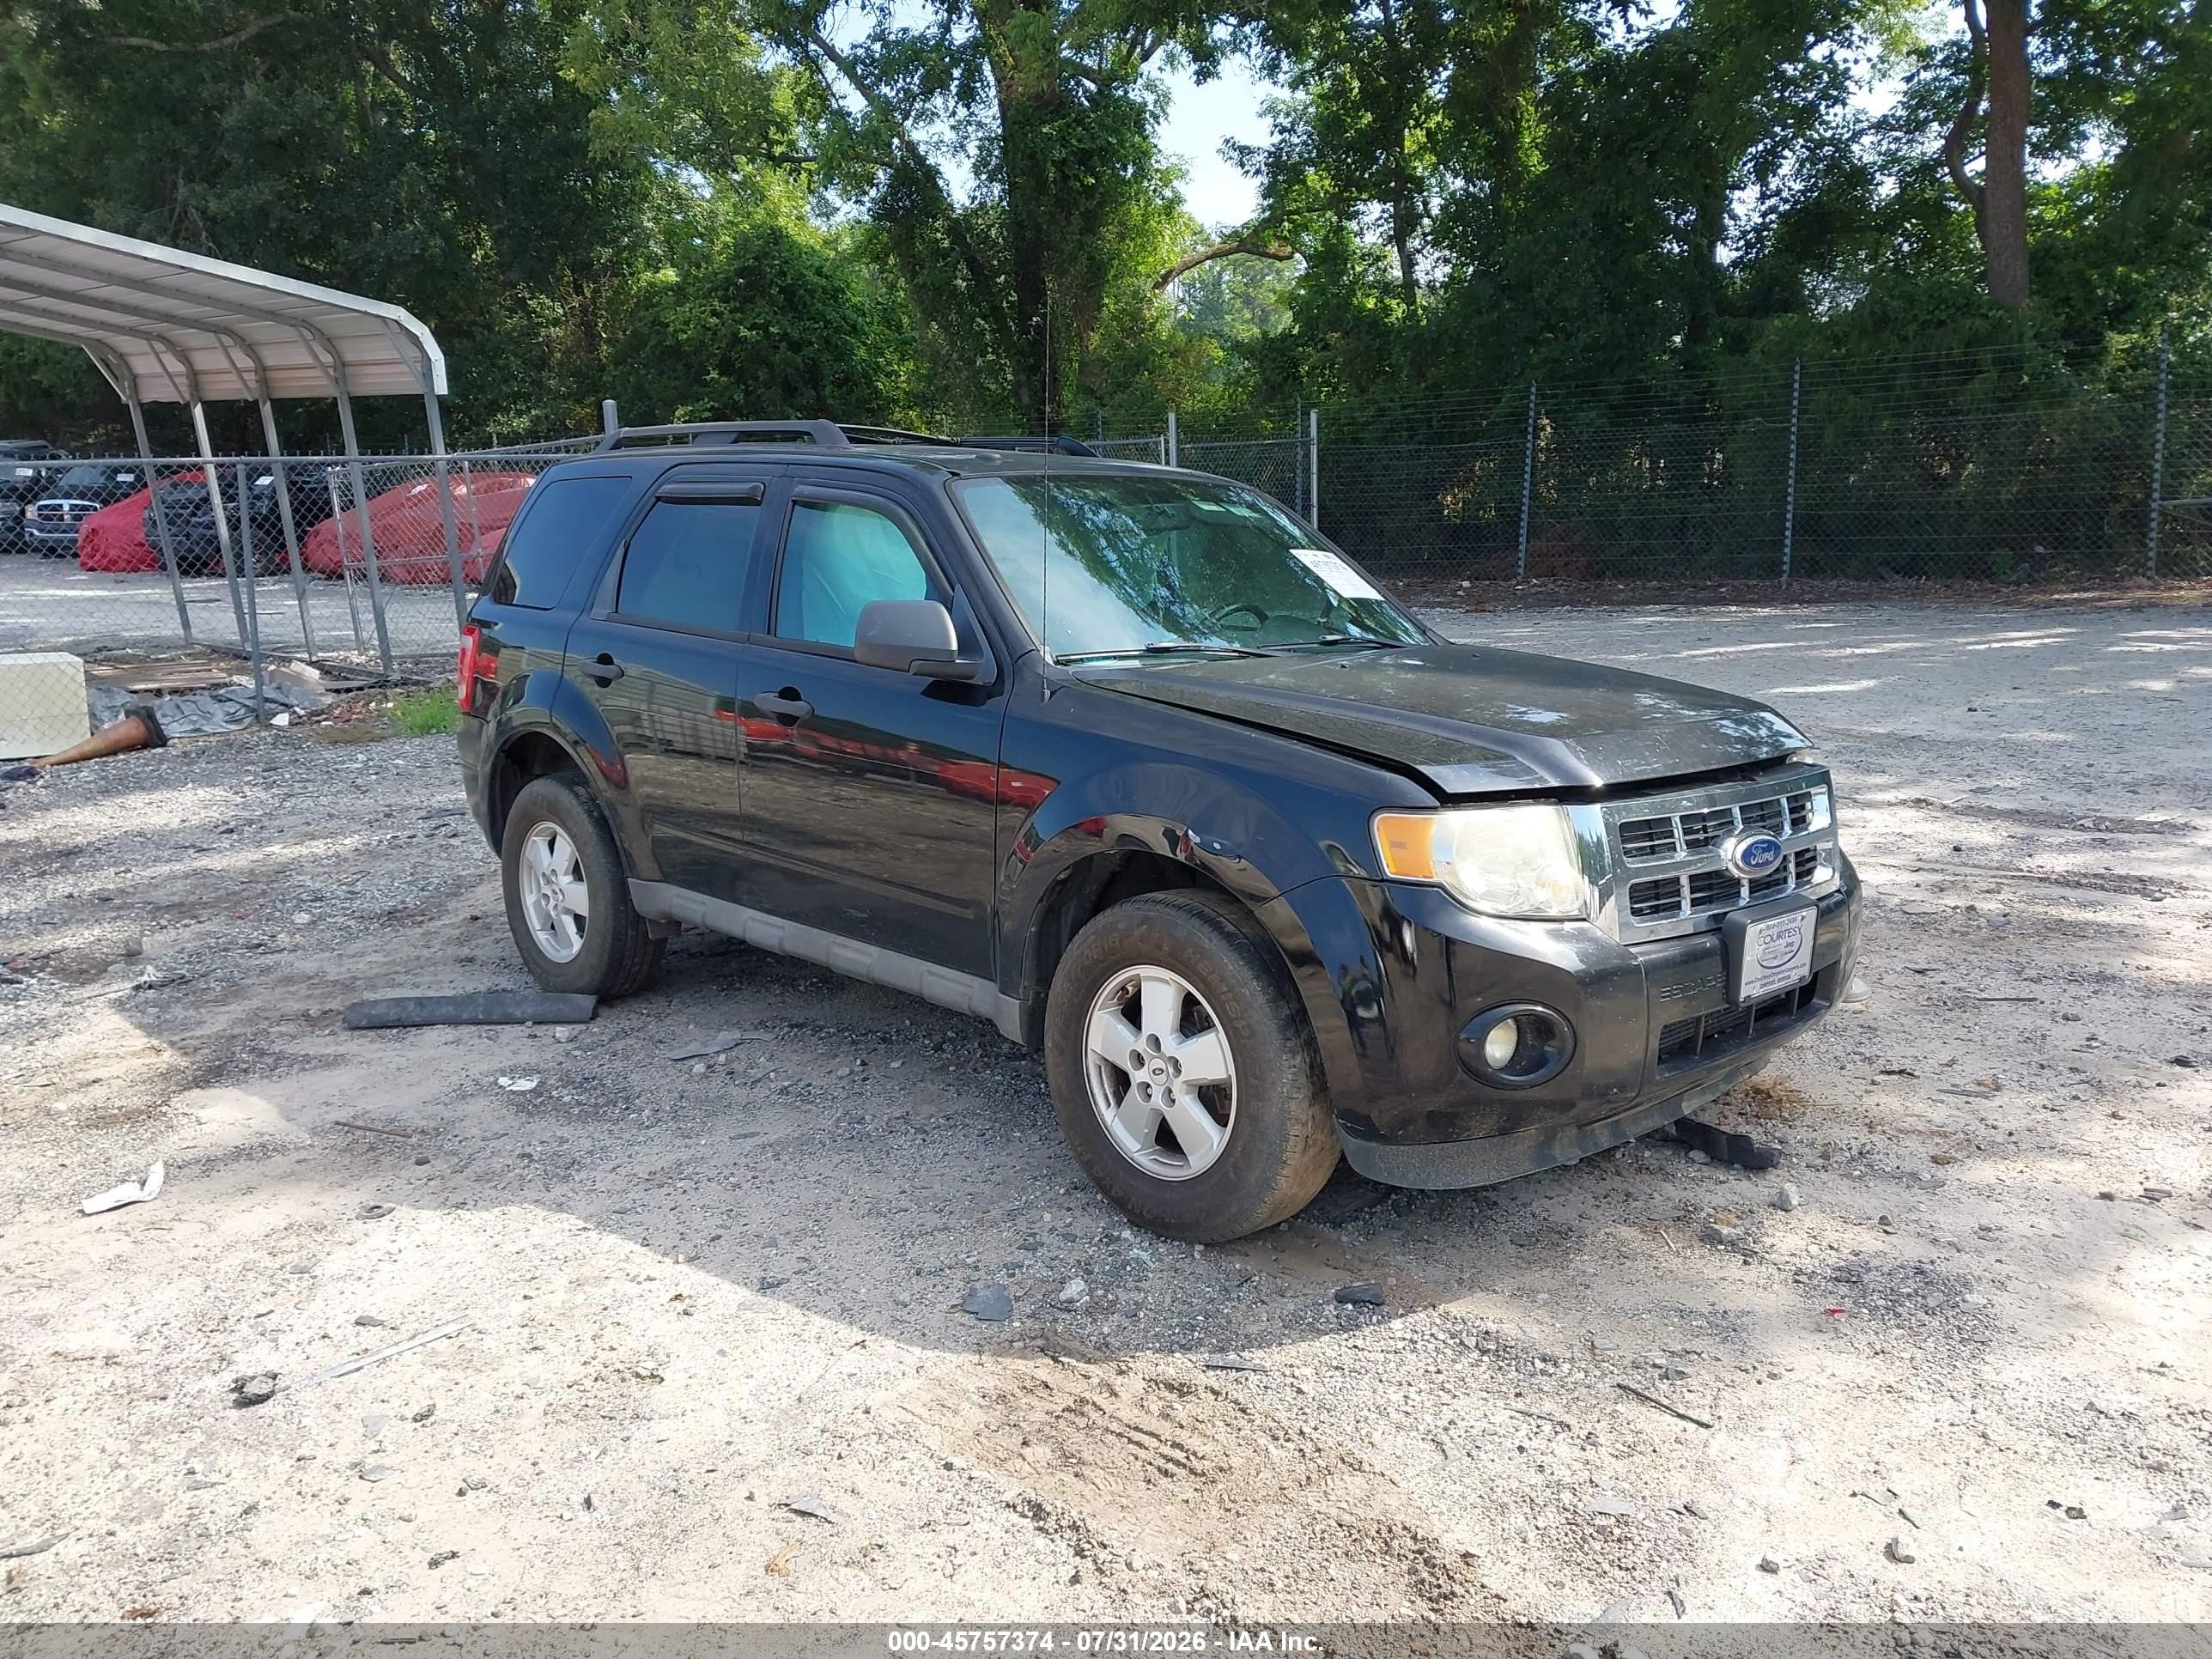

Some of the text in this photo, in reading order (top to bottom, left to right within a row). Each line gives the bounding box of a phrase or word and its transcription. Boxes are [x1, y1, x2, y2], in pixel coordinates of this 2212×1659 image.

[1751, 843, 1775, 865] Ford
[1756, 925, 1803, 946] COURTESY
[1659, 971, 1726, 1002] ESCAPE
